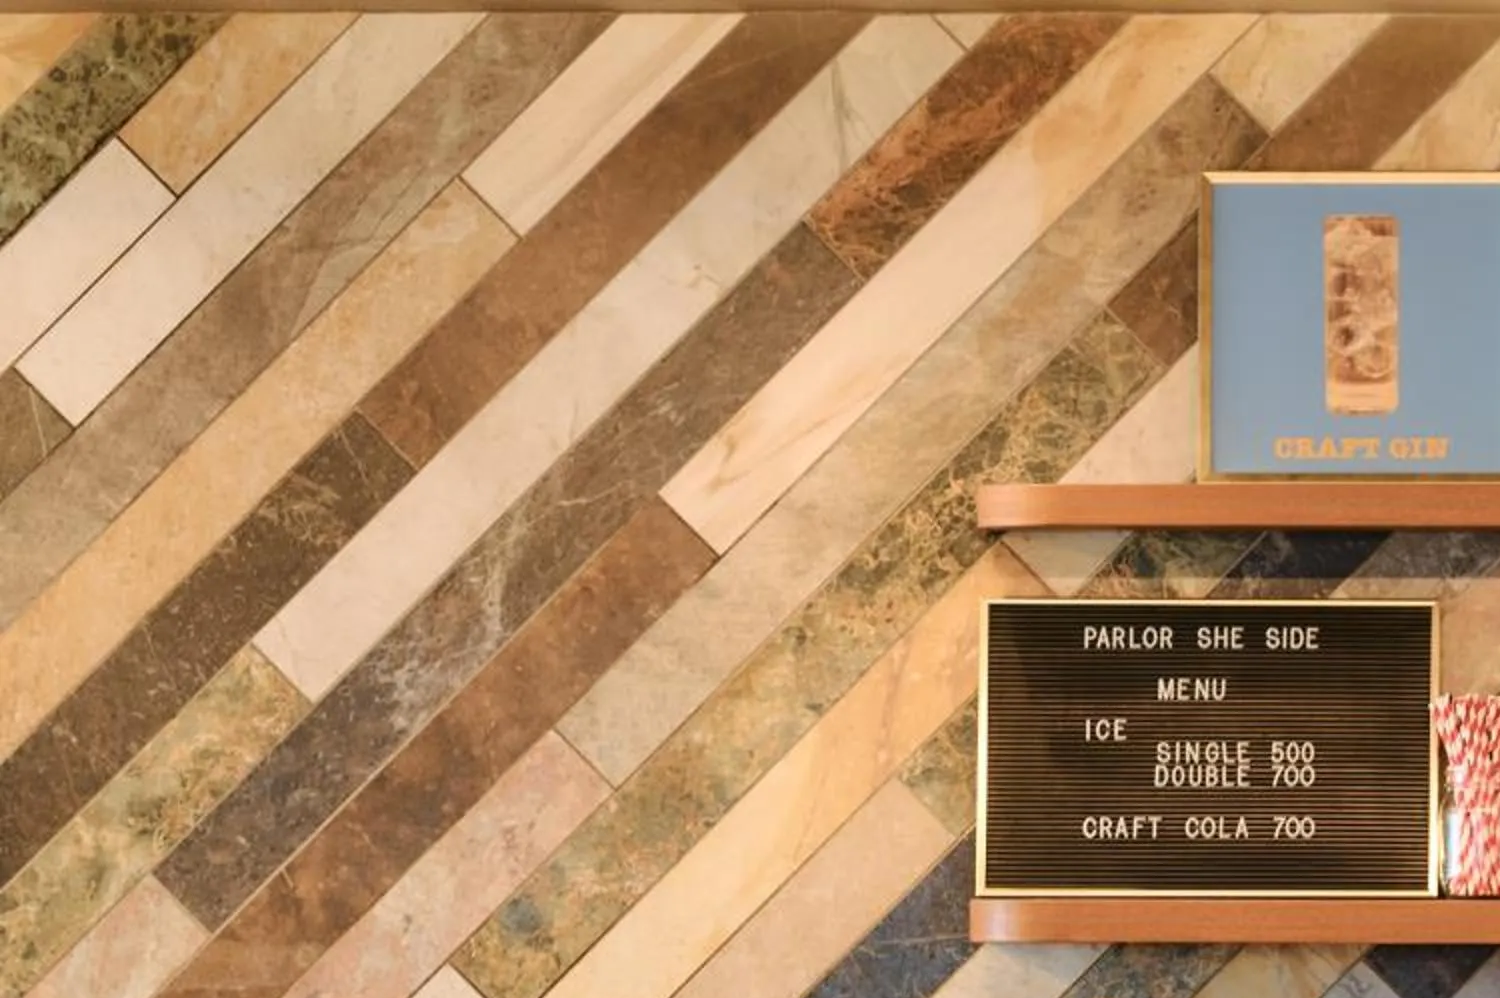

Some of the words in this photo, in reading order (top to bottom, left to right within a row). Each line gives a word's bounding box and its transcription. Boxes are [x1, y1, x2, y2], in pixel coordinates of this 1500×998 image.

[1275, 436, 1381, 460] CRAFT
[1389, 436, 1450, 460] GIN
[1083, 625, 1174, 649] PARLOR
[1196, 626, 1245, 649] SHE
[1264, 626, 1320, 650] SIDE
[1156, 677, 1228, 701] MENU
[1084, 717, 1128, 741] ICE
[1155, 740, 1251, 764] SINGLE
[1270, 740, 1316, 763] 500
[1153, 764, 1251, 788] DOUBLE
[1271, 764, 1316, 787] 700
[1081, 815, 1163, 840] CRAFT
[1183, 815, 1250, 839] COLA
[1273, 815, 1316, 839] 700
